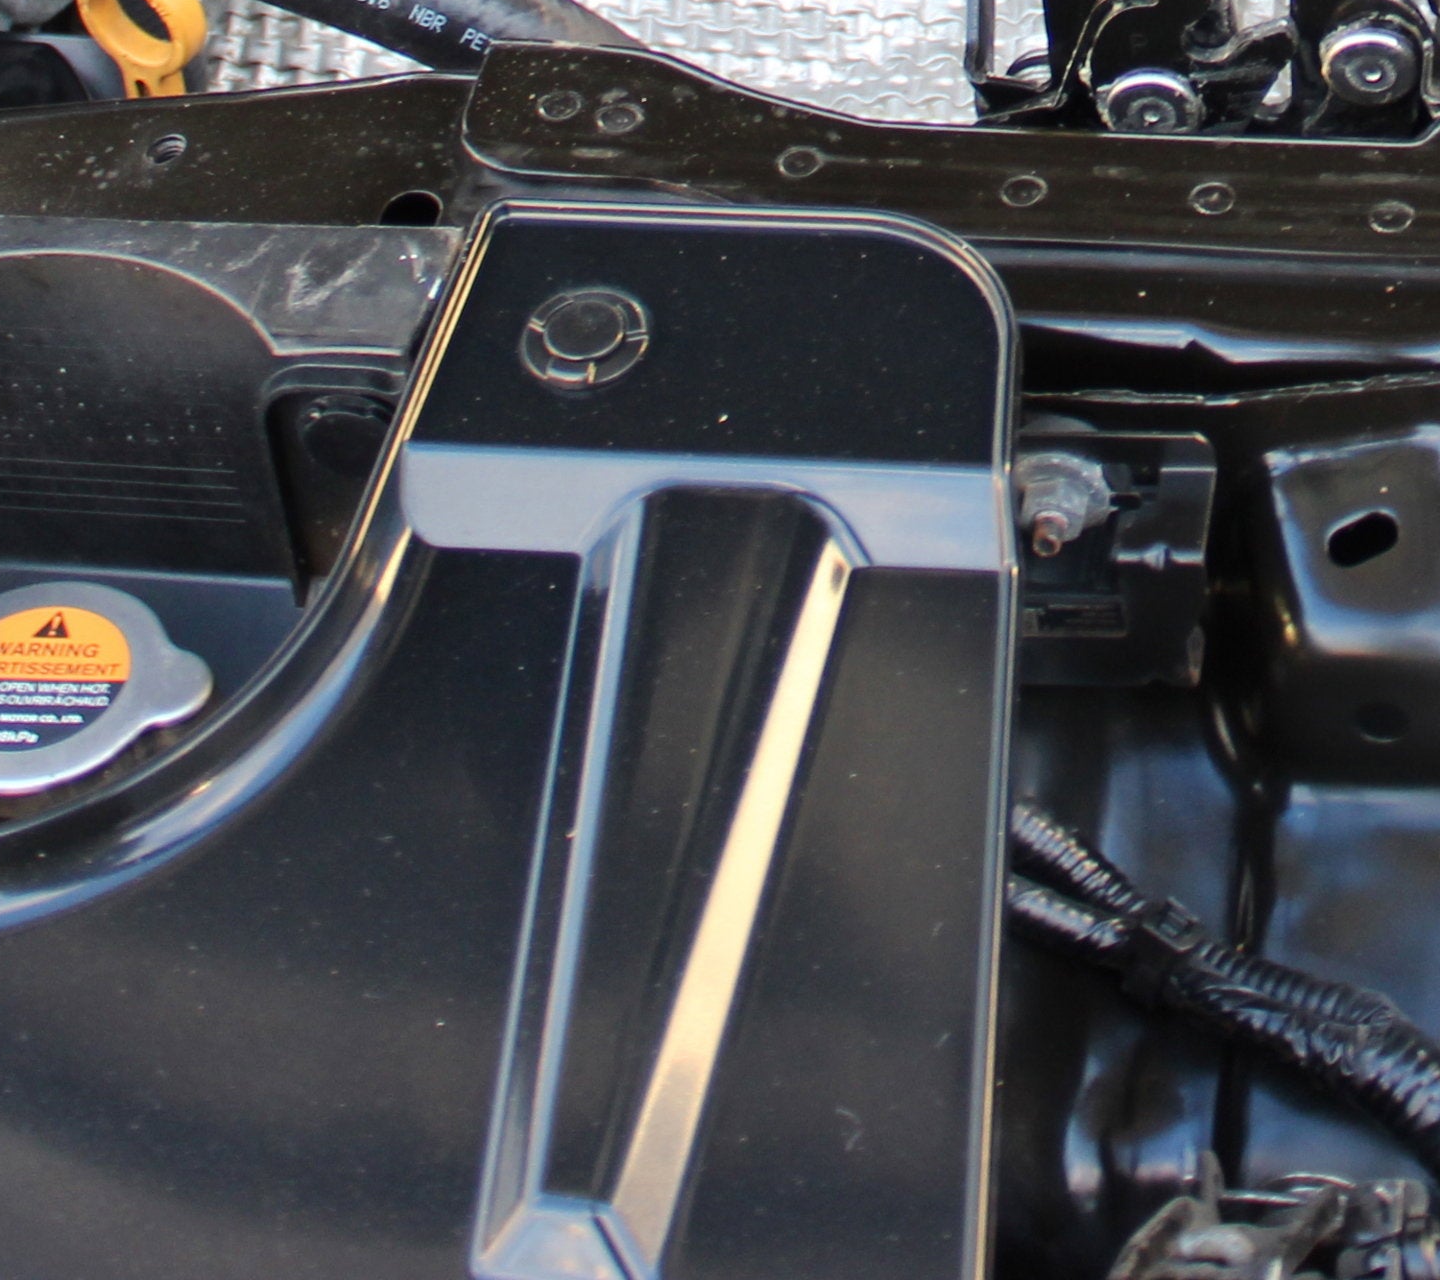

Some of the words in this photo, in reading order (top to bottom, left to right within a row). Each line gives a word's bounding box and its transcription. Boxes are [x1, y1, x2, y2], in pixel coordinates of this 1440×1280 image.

[408, 4, 447, 33] NBR
[37, 682, 79, 693] WHEN
[0, 712, 39, 722] MOTOR
